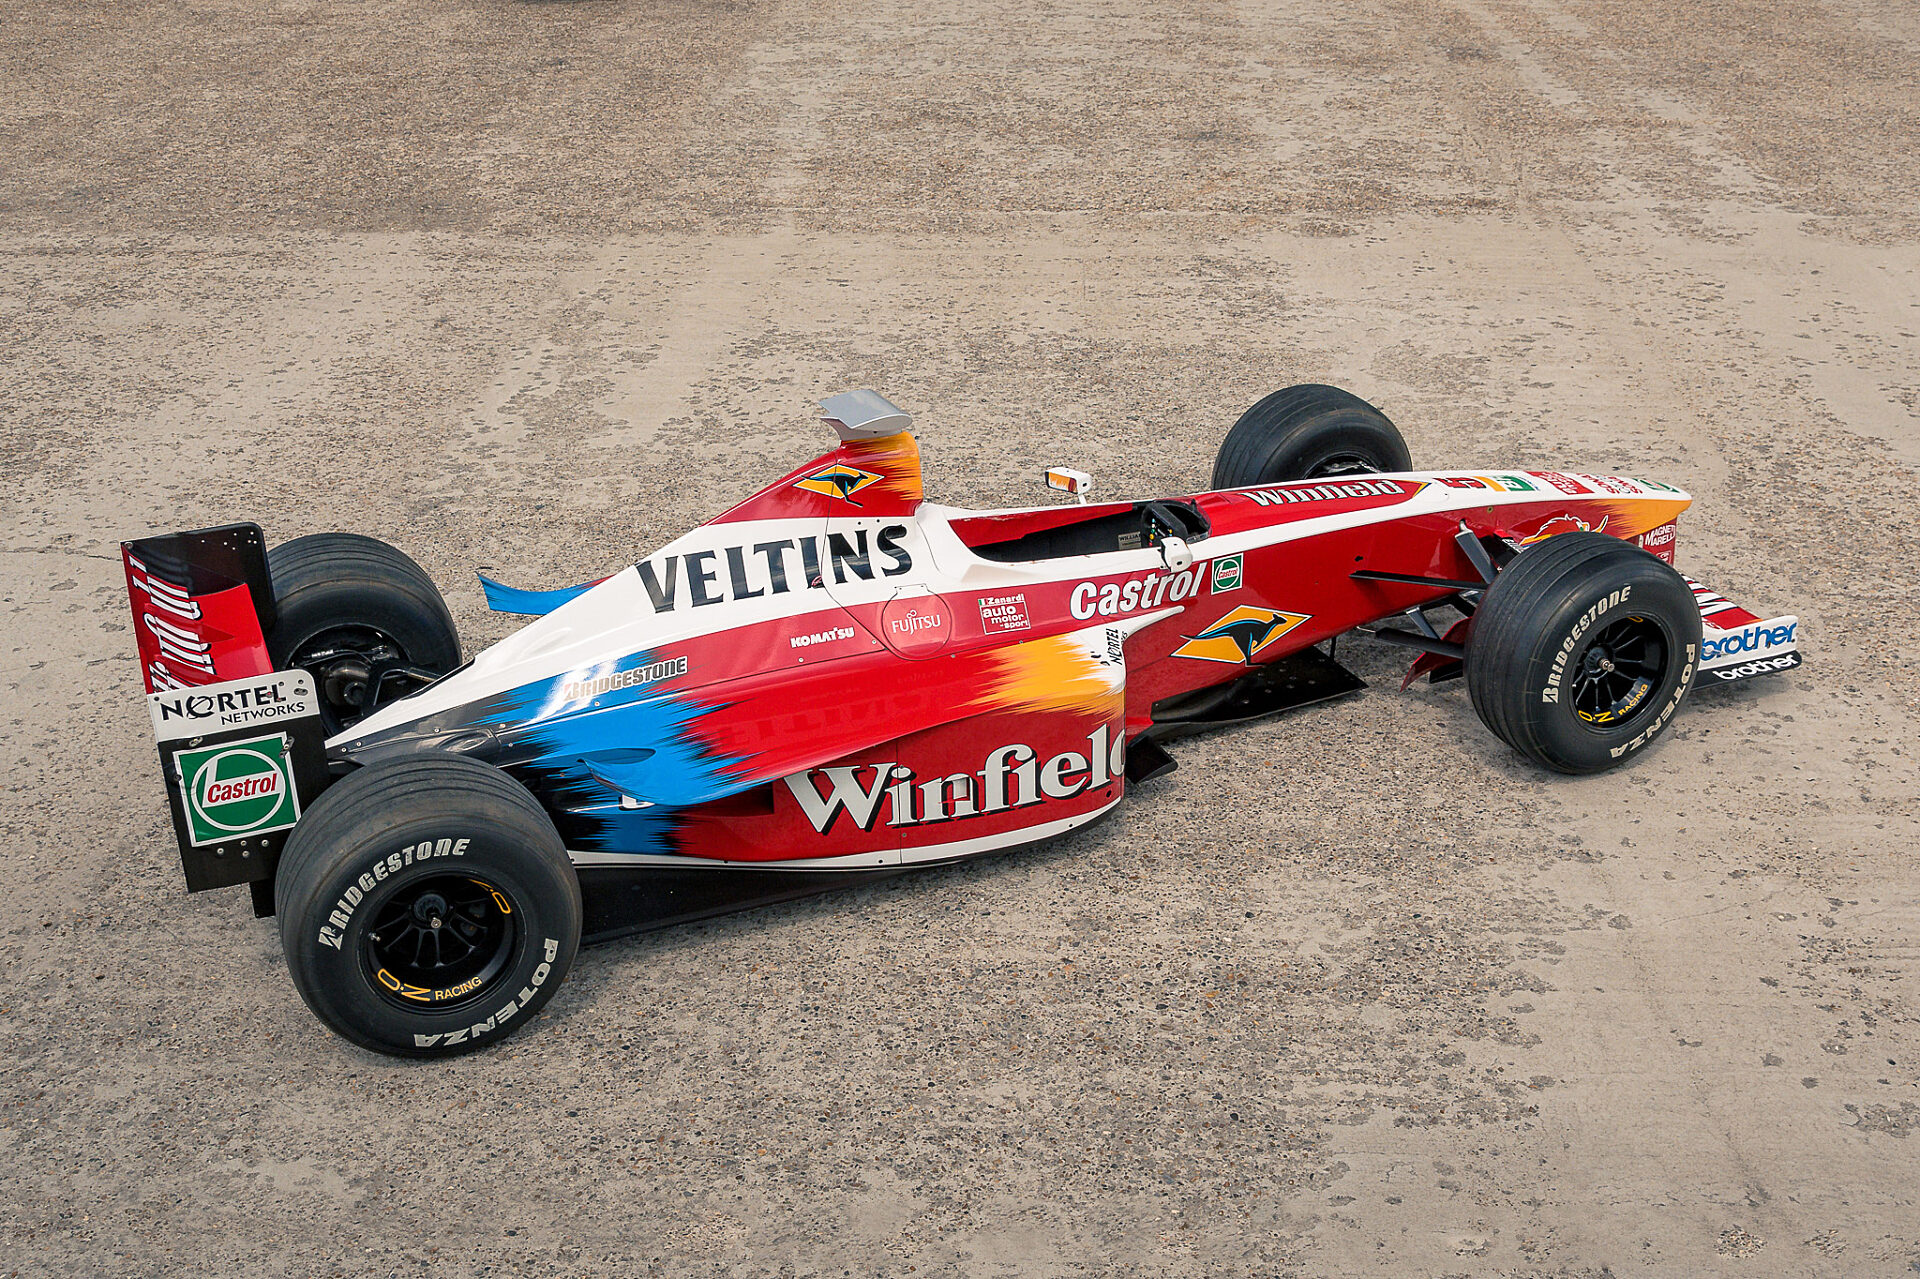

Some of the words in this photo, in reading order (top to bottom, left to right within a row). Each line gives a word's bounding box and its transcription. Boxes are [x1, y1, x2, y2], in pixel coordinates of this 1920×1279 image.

[1238, 479, 1405, 506] Winfield
[634, 524, 913, 614] VELTINS
[1218, 568, 1239, 579] Castrol
[1070, 562, 1209, 621] Castrol
[892, 609, 942, 635] FUJITSU
[982, 605, 1017, 618] auto
[991, 613, 1025, 624] motor
[790, 626, 856, 649] KOMATSU
[1541, 585, 1632, 704] BRIDGESTONE
[1700, 621, 1798, 661] brother
[563, 655, 688, 702] BRIDGESTONE
[1712, 654, 1800, 680] brother
[159, 684, 287, 721] NORTEL
[220, 701, 306, 726] NETWORKS
[1609, 643, 1696, 758] POTENZA
[1618, 683, 1649, 717] RACING
[207, 773, 278, 804] Castrol
[318, 838, 471, 950] BRIDGESTONE
[413, 938, 559, 1047] POTENZA
[434, 976, 483, 1001] RACING
